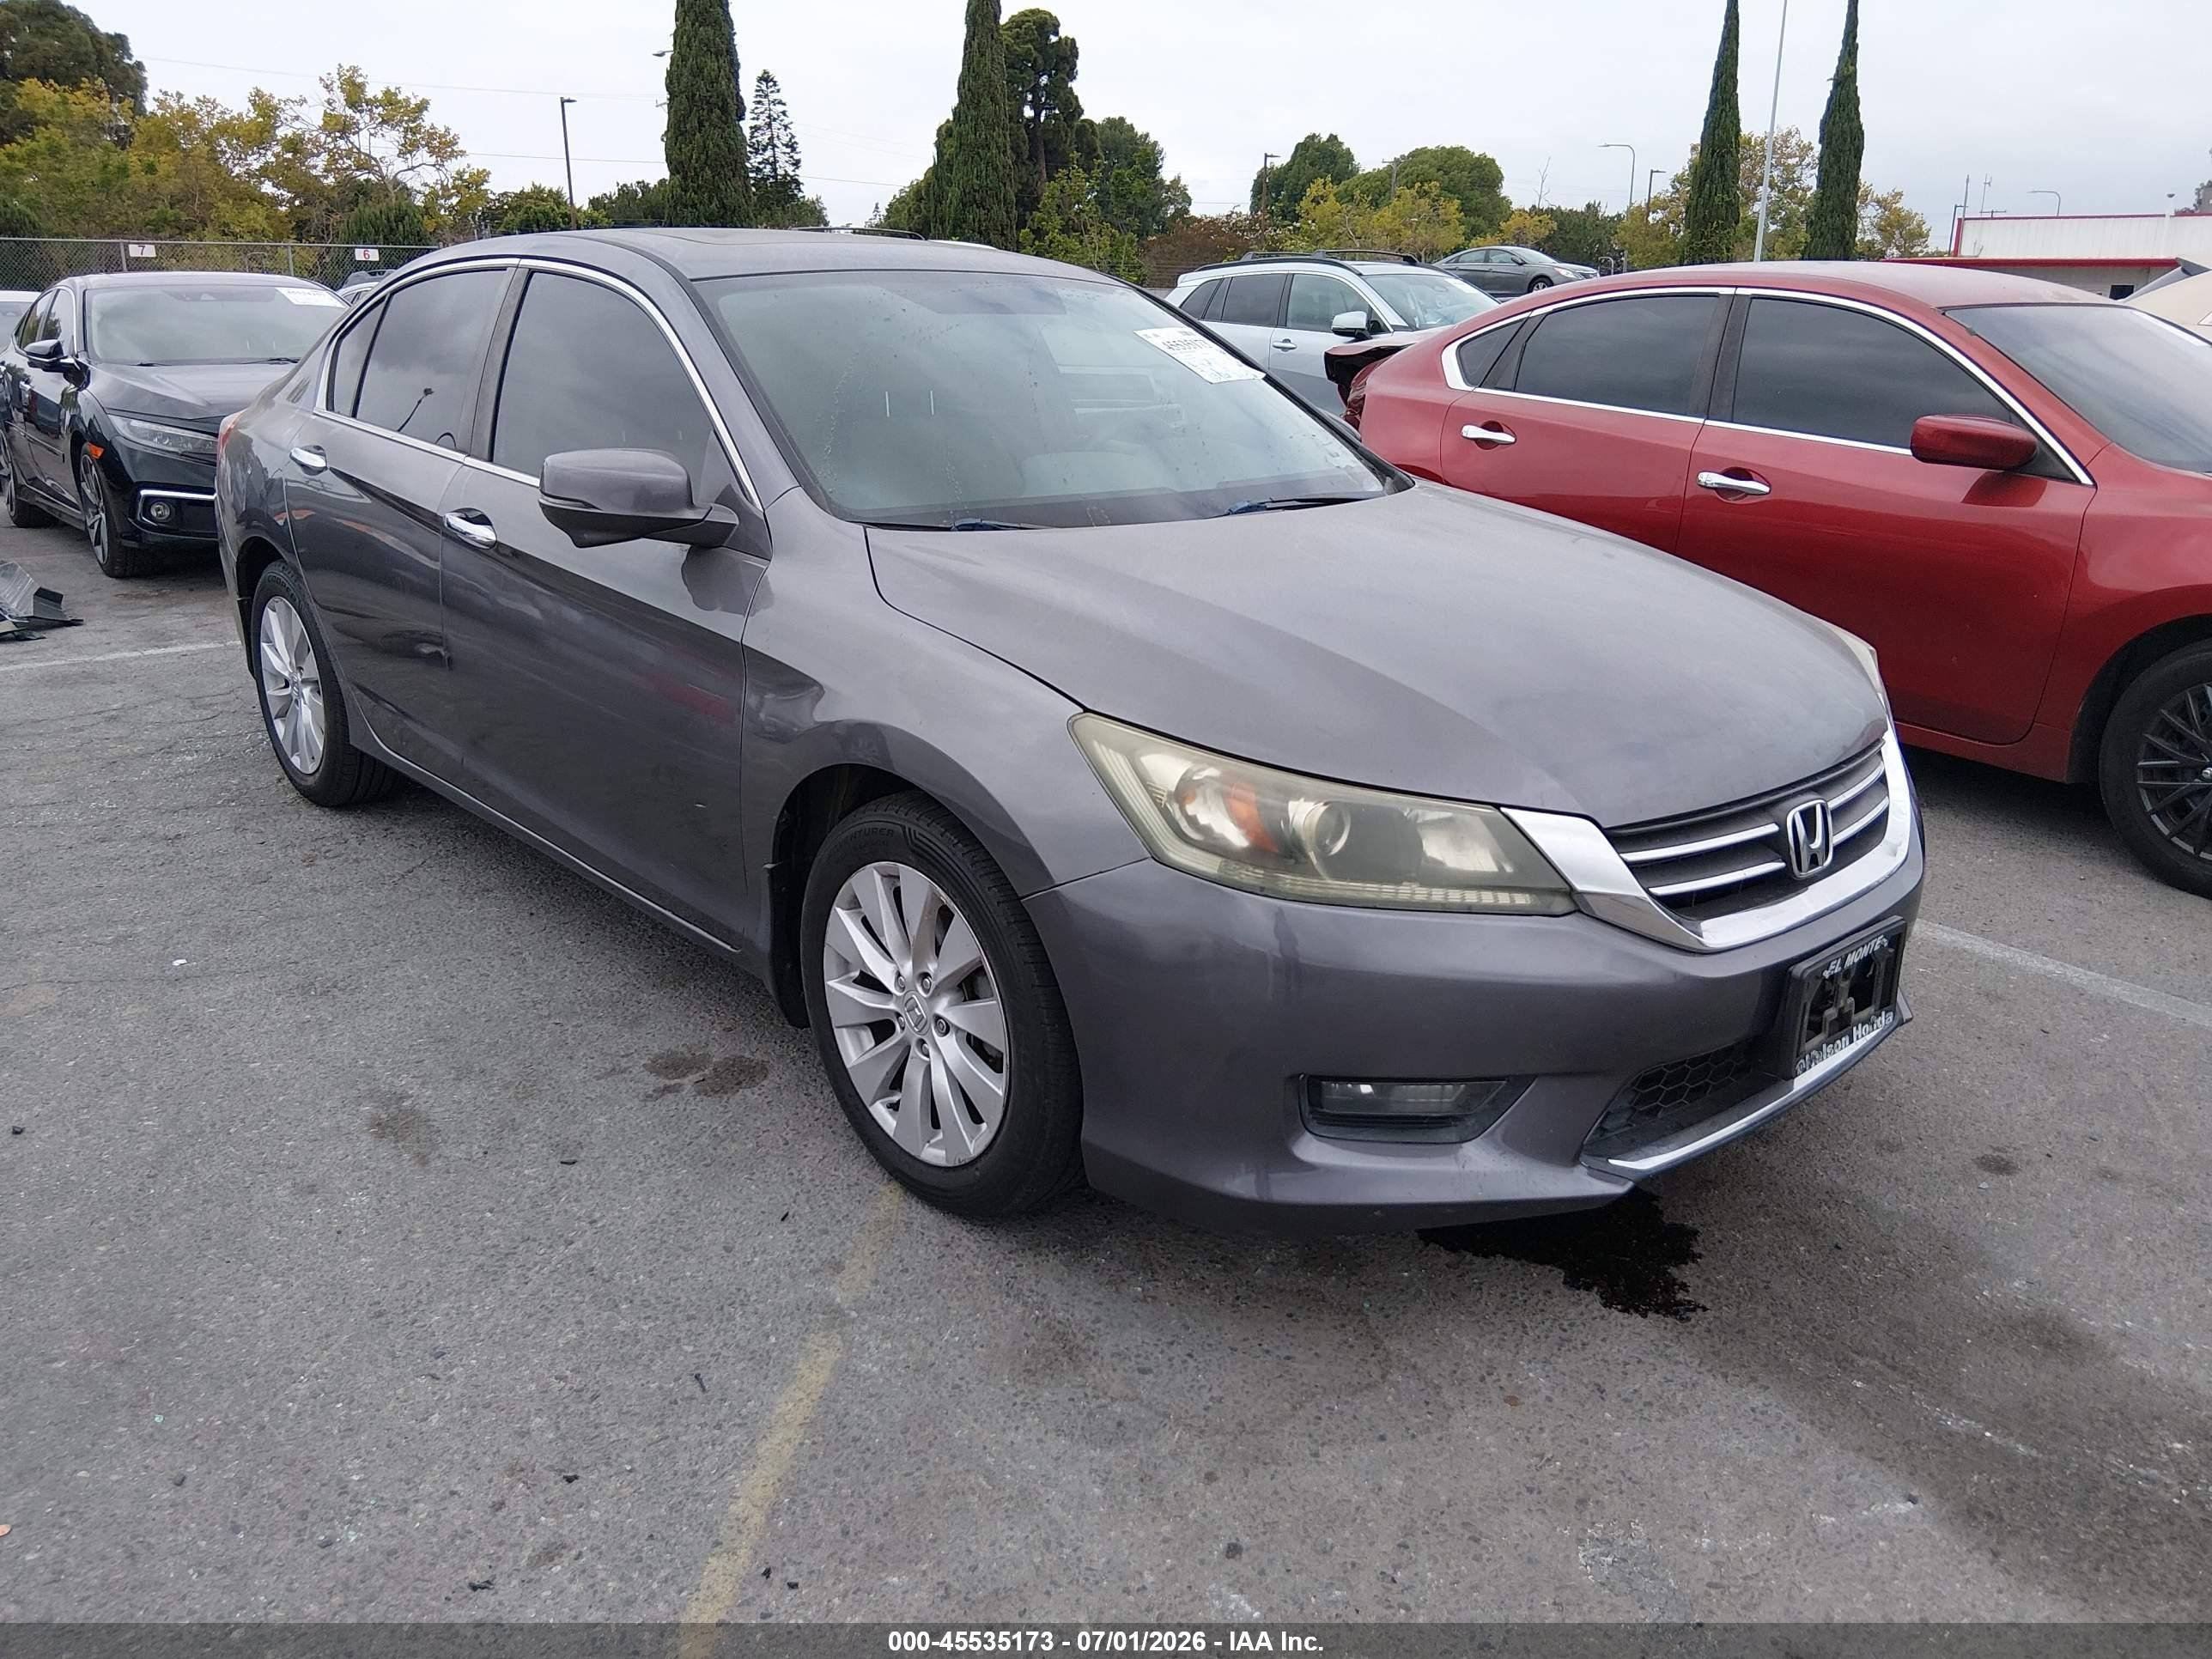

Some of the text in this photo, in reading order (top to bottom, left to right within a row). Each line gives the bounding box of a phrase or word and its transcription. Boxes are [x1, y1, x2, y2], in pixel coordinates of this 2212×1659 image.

[137, 245, 146, 256] 7
[362, 249, 371, 260] 6
[1826, 934, 1884, 975] EL MONTE
